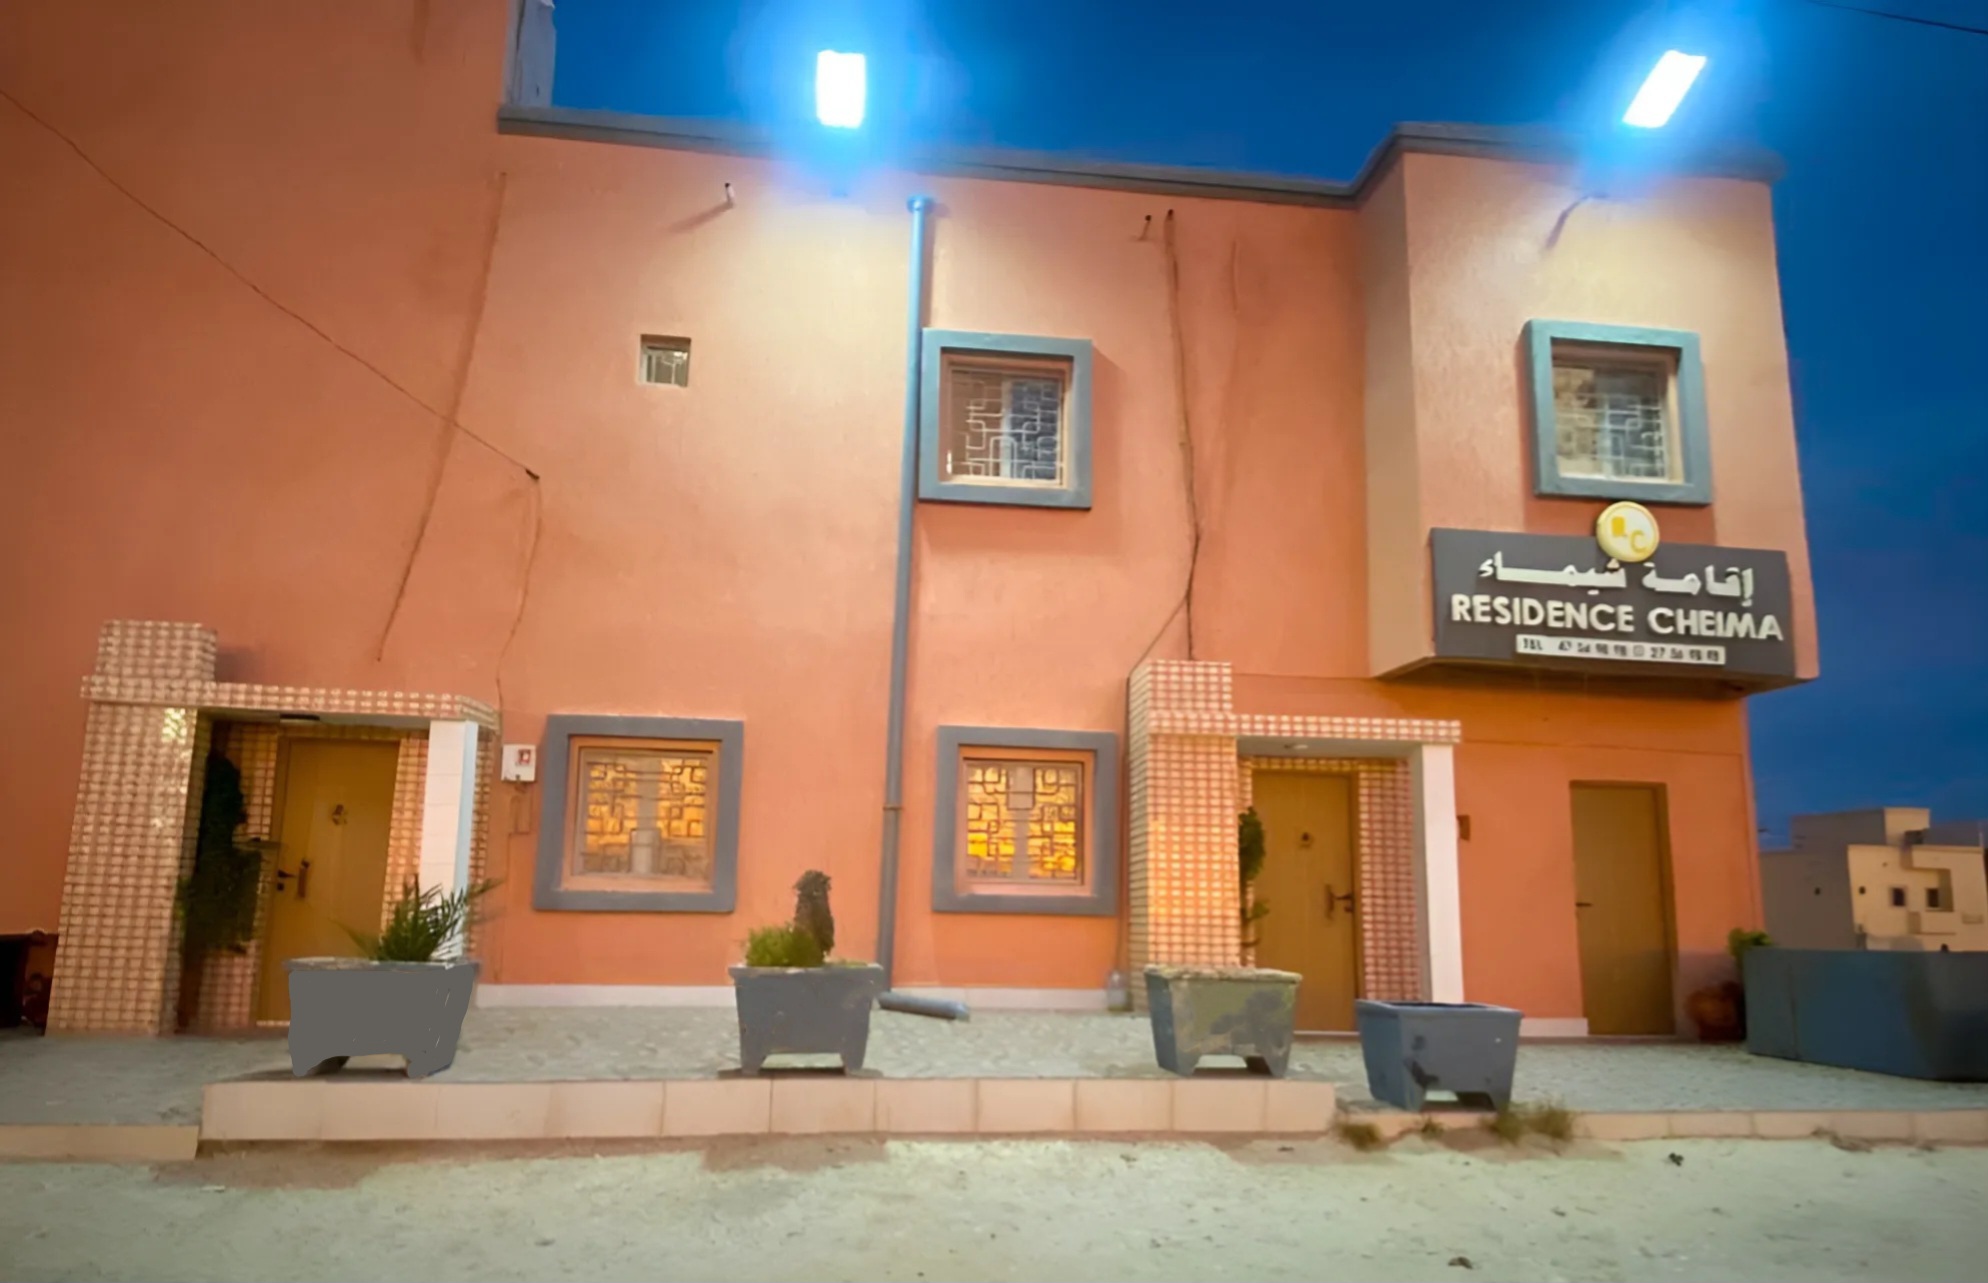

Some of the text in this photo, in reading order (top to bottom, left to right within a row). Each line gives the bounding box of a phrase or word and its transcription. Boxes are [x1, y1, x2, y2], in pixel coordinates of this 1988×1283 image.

[1479, 551, 1754, 607] إقامة شيماء
[1451, 594, 1785, 641] RESIDENCE CHEIMA
